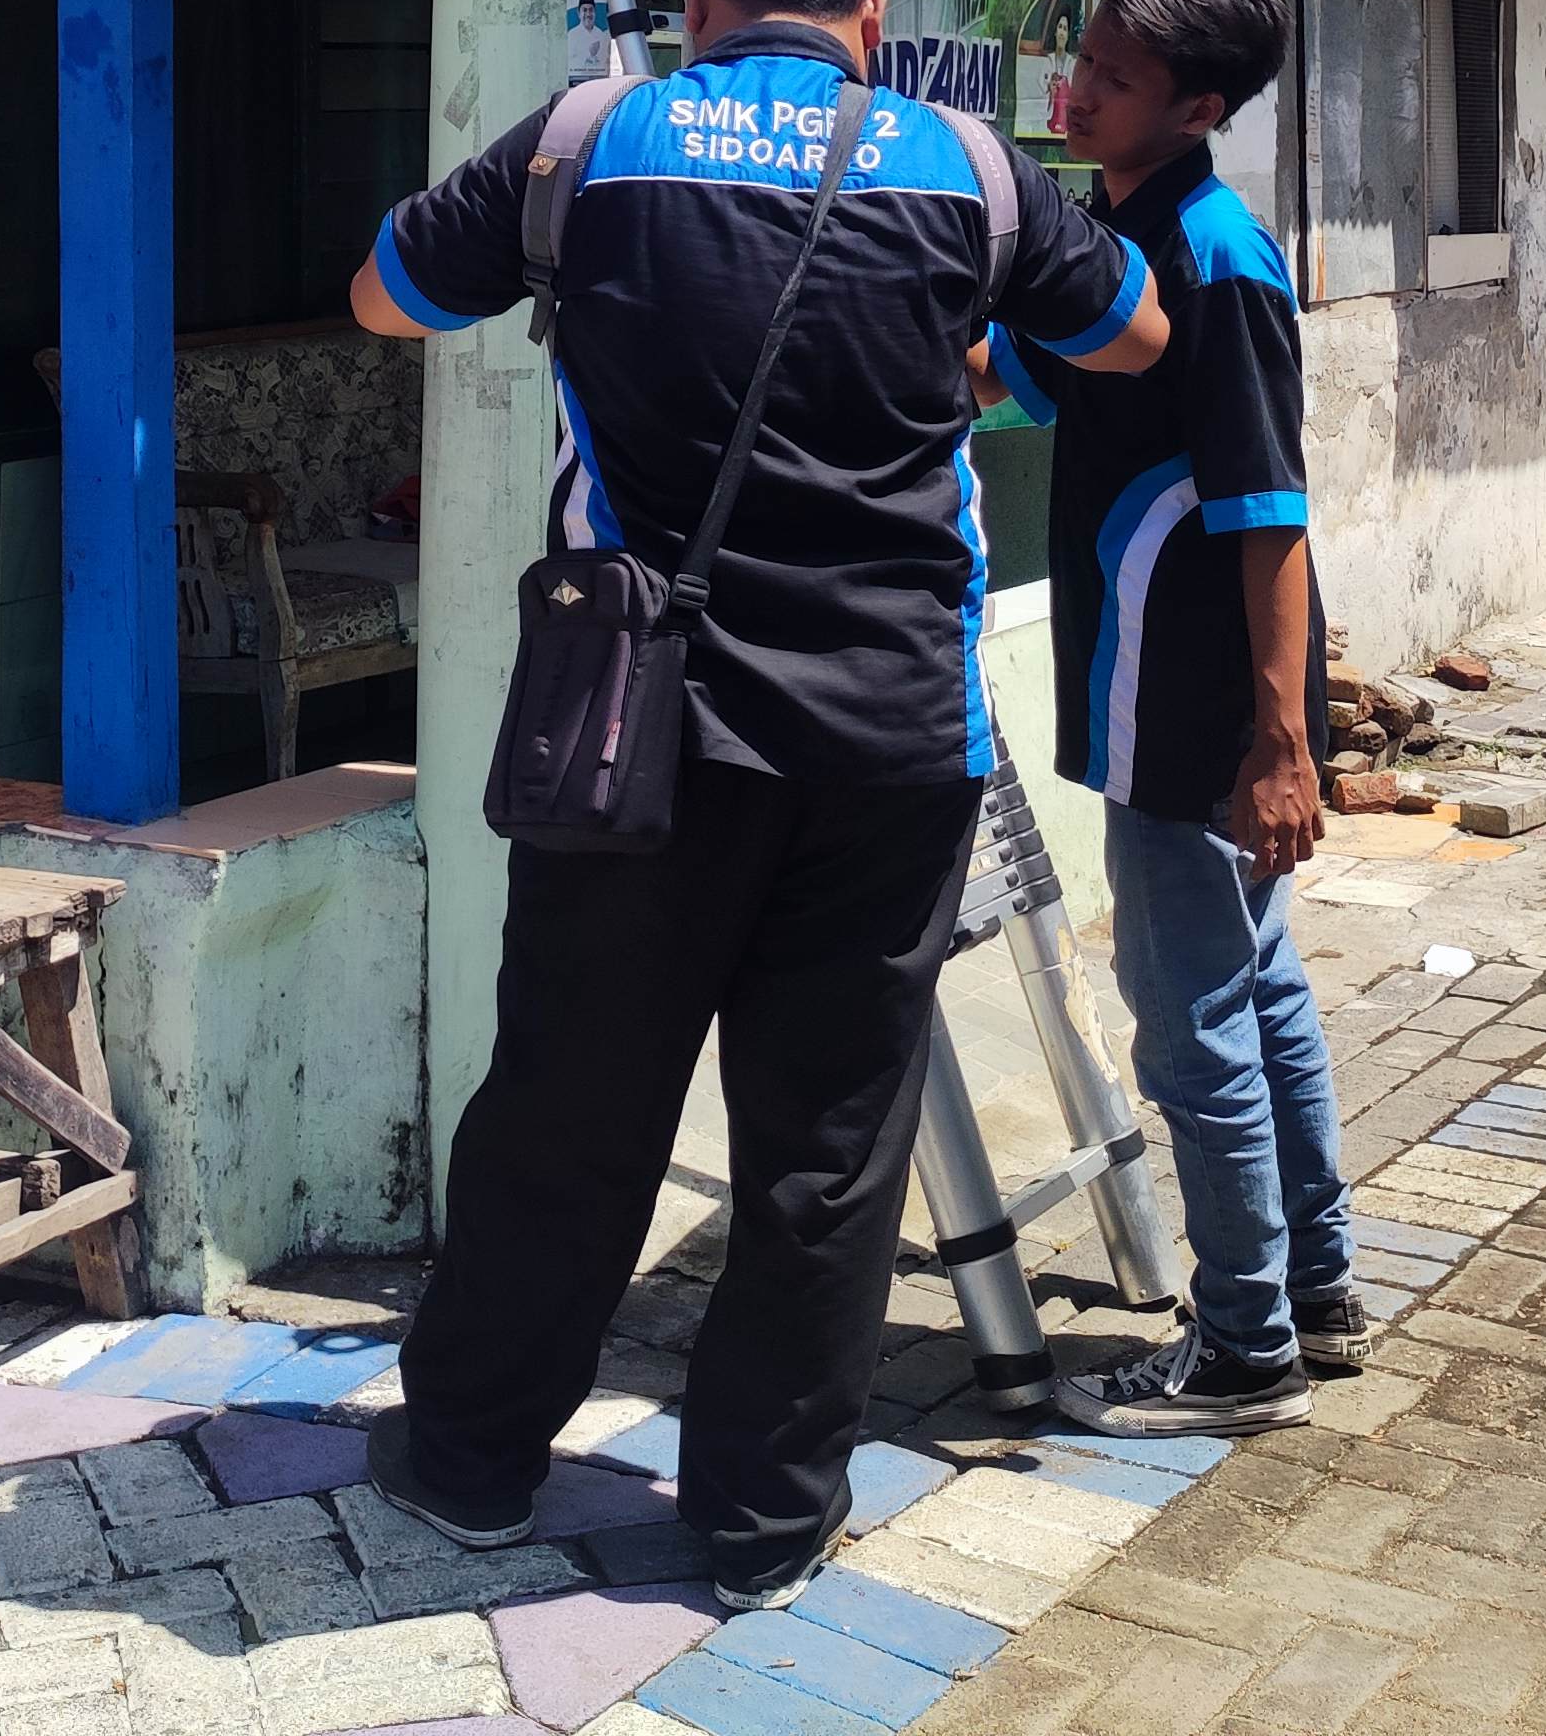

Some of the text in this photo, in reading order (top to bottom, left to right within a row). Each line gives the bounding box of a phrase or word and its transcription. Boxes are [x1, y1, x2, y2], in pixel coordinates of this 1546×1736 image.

[668, 96, 760, 135] SMK
[873, 110, 901, 138] 2
[683, 130, 883, 172] SIDOARO
